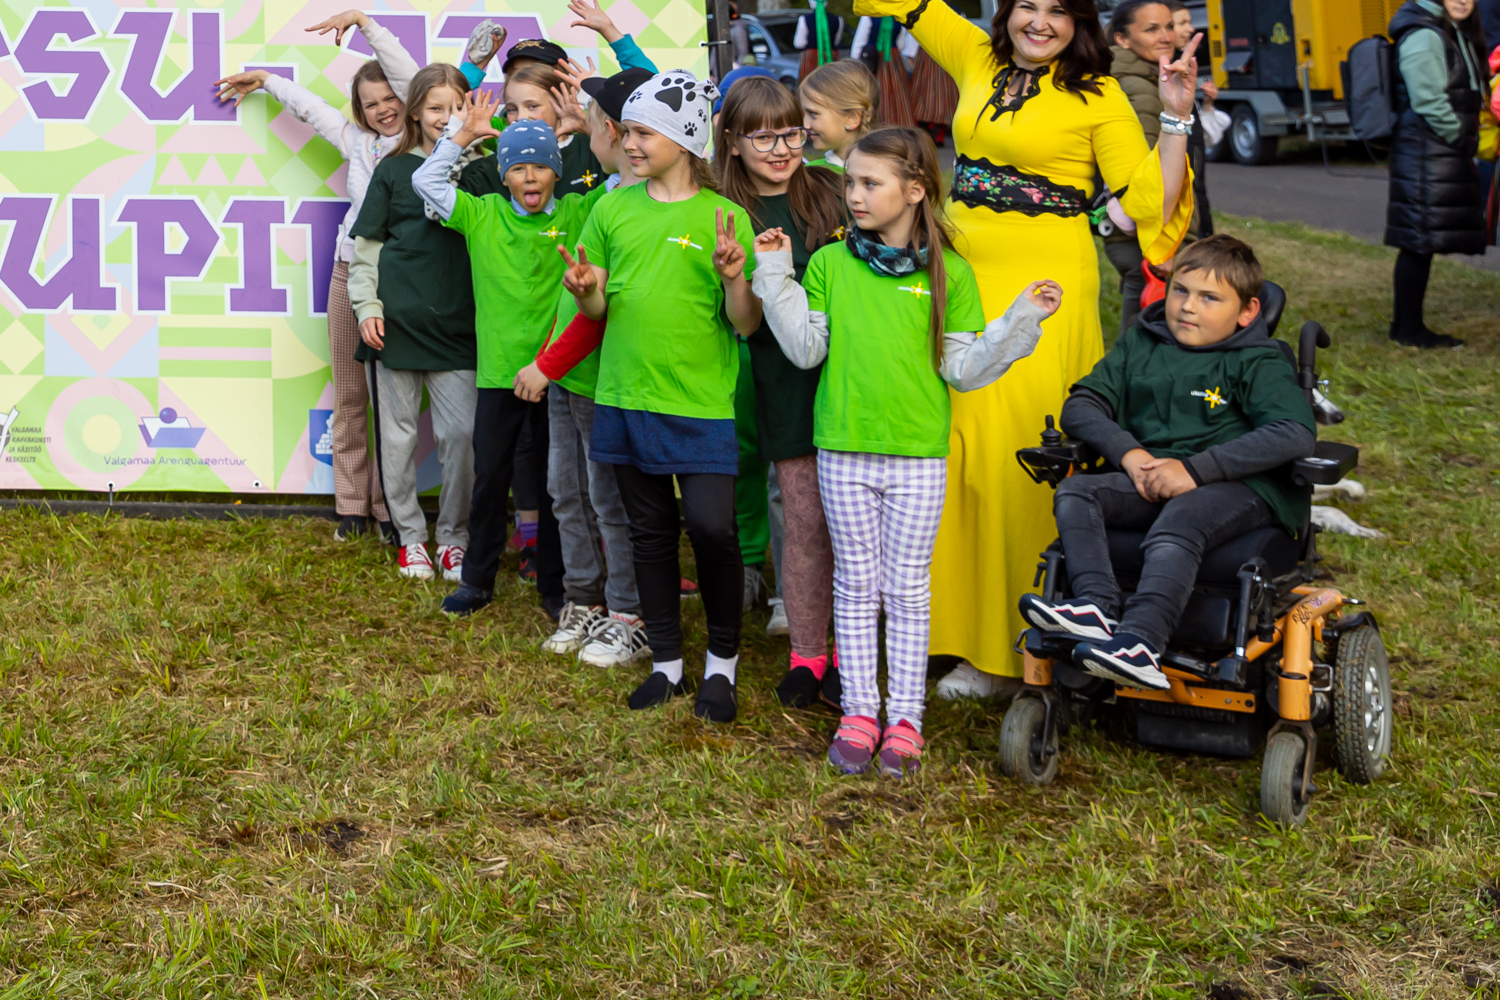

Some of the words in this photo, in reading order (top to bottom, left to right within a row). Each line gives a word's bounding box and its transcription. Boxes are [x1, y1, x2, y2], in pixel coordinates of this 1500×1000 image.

[11, 426, 42, 434] VALGAMAA
[103, 455, 156, 467] Valgamaa
[158, 455, 248, 468] Arenguagentuur
